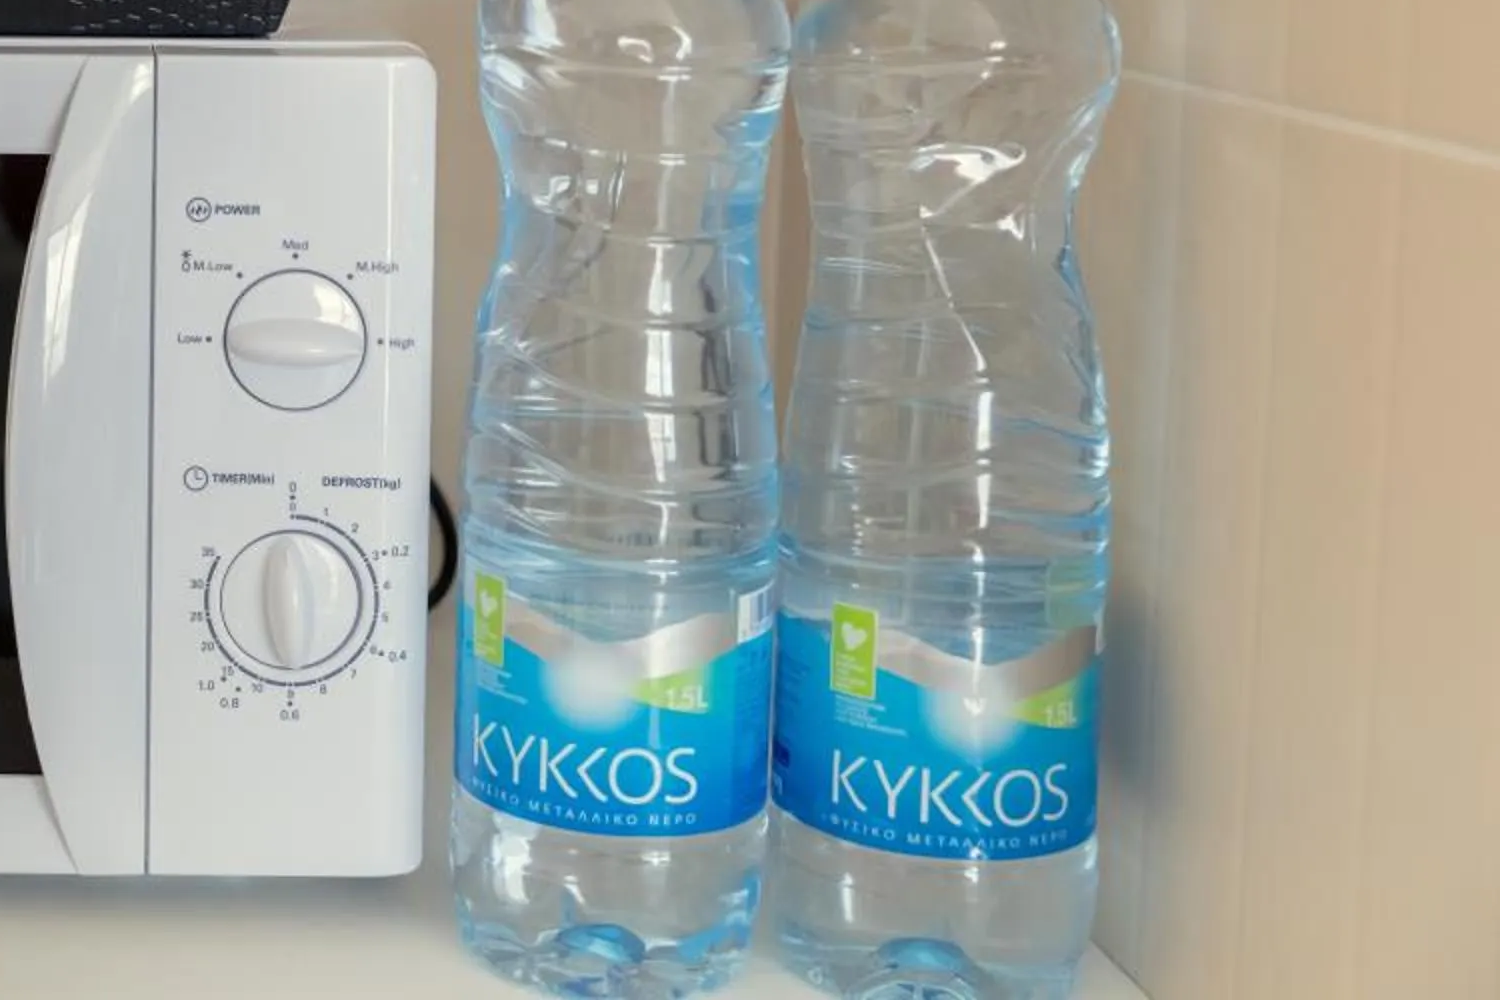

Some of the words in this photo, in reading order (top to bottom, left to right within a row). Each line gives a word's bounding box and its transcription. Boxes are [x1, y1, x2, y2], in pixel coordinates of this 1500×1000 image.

[214, 204, 261, 216] POWER
[281, 239, 310, 251] Med
[193, 260, 234, 272] M.Low
[355, 261, 400, 274] M.High
[177, 334, 203, 344] Low
[389, 337, 415, 350] High
[211, 472, 275, 486] TIMER(Min)
[321, 475, 402, 491] DEFROST(kg)
[289, 481, 297, 493] 0
[352, 523, 360, 534] 2
[372, 549, 380, 561] 3
[391, 546, 410, 558] 0.2
[190, 579, 204, 590] 30
[189, 611, 203, 622] 25
[201, 640, 215, 651] 20
[388, 650, 408, 662] 0.4
[222, 665, 235, 677] 15
[198, 680, 215, 691] 1.0
[251, 682, 263, 693] 10
[219, 697, 240, 709] 0.8
[279, 709, 300, 721] 0.6
[472, 712, 699, 805] KYKKOS
[831, 748, 1069, 828] KYKKOS
